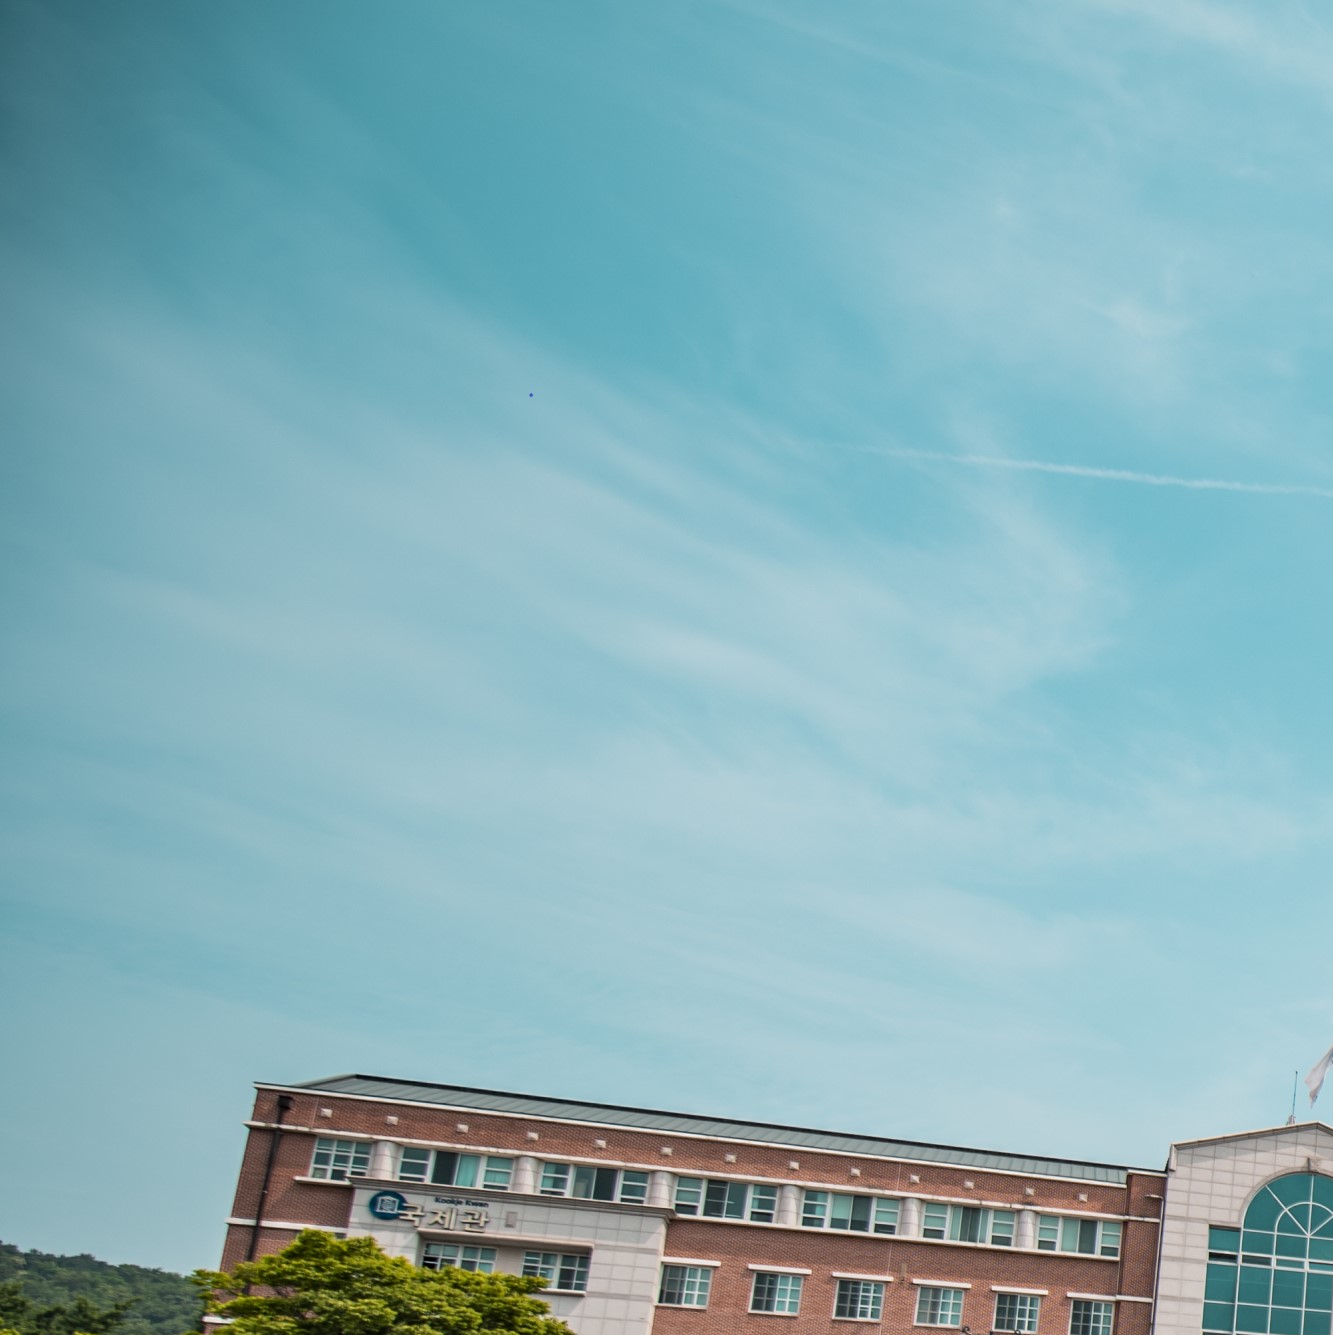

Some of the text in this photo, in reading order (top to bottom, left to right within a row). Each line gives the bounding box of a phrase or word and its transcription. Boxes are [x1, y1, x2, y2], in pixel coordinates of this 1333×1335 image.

[434, 1197, 490, 1208] Kookje Kwan
[398, 1203, 490, 1233] 국제관
